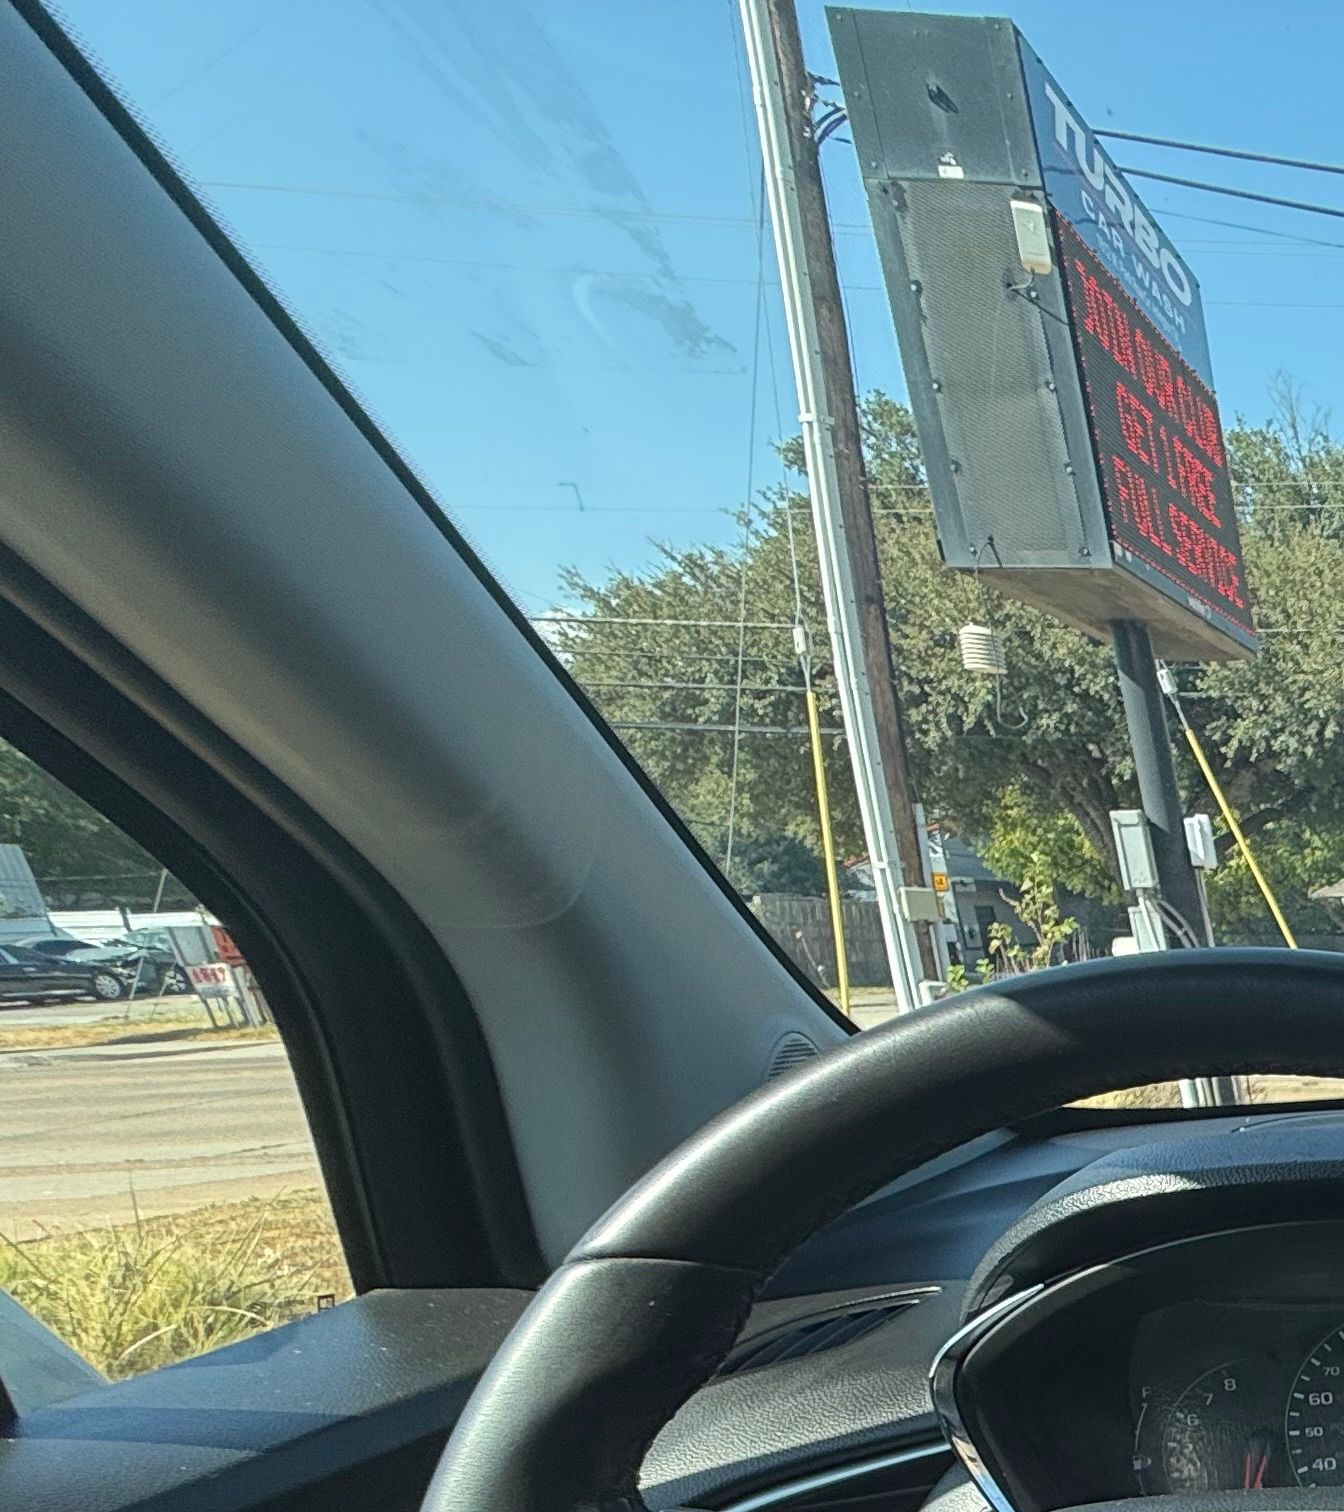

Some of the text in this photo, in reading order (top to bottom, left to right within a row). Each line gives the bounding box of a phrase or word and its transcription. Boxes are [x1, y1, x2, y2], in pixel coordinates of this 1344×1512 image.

[1045, 82, 1192, 307] TURBO
[1080, 190, 1125, 258] CAR
[1132, 254, 1187, 335] WASH
[1116, 381, 1159, 473] GET
[1173, 436, 1221, 528] FREE
[1112, 455, 1172, 555] FULL
[1323, 1366, 1340, 1376] 70
[1223, 1378, 1237, 1391] 8
[1203, 1393, 1213, 1406] 7
[1308, 1391, 1333, 1406] 60
[1186, 1413, 1199, 1426] 6
[1305, 1426, 1323, 1437] 50
[1311, 1457, 1337, 1471] 40
